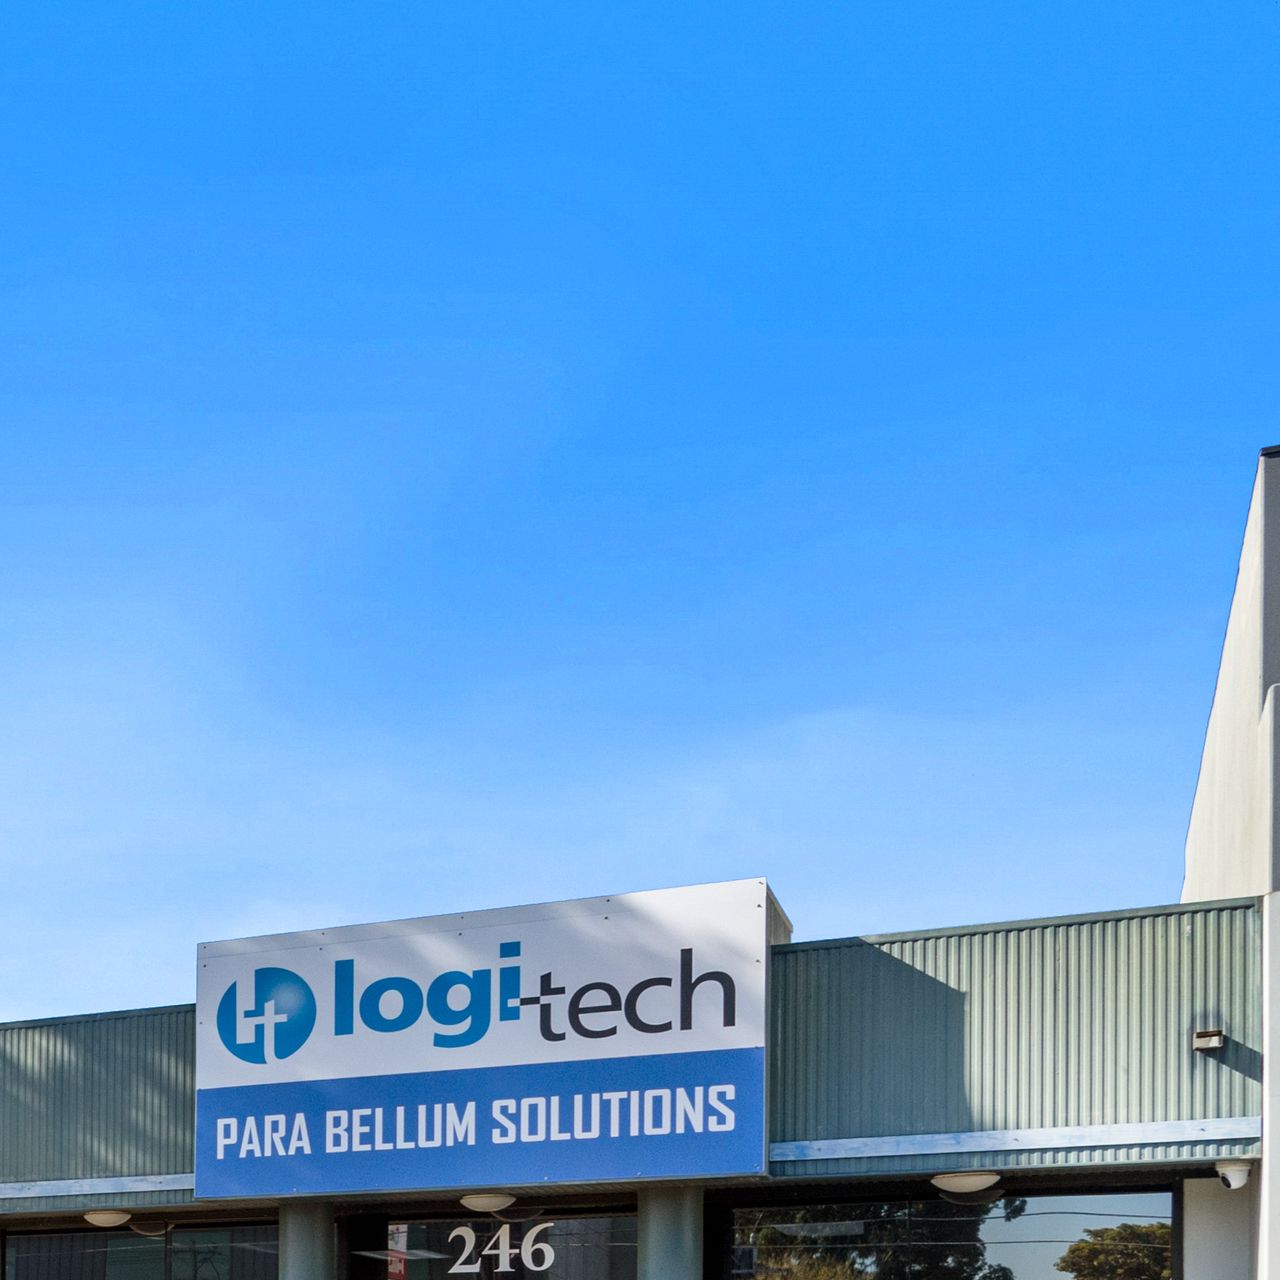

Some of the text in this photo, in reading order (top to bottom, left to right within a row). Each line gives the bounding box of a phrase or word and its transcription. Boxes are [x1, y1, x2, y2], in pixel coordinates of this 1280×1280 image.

[216, 1084, 736, 1160] PARA BELLUM SOLUTIONS
[447, 1222, 555, 1274] 246
